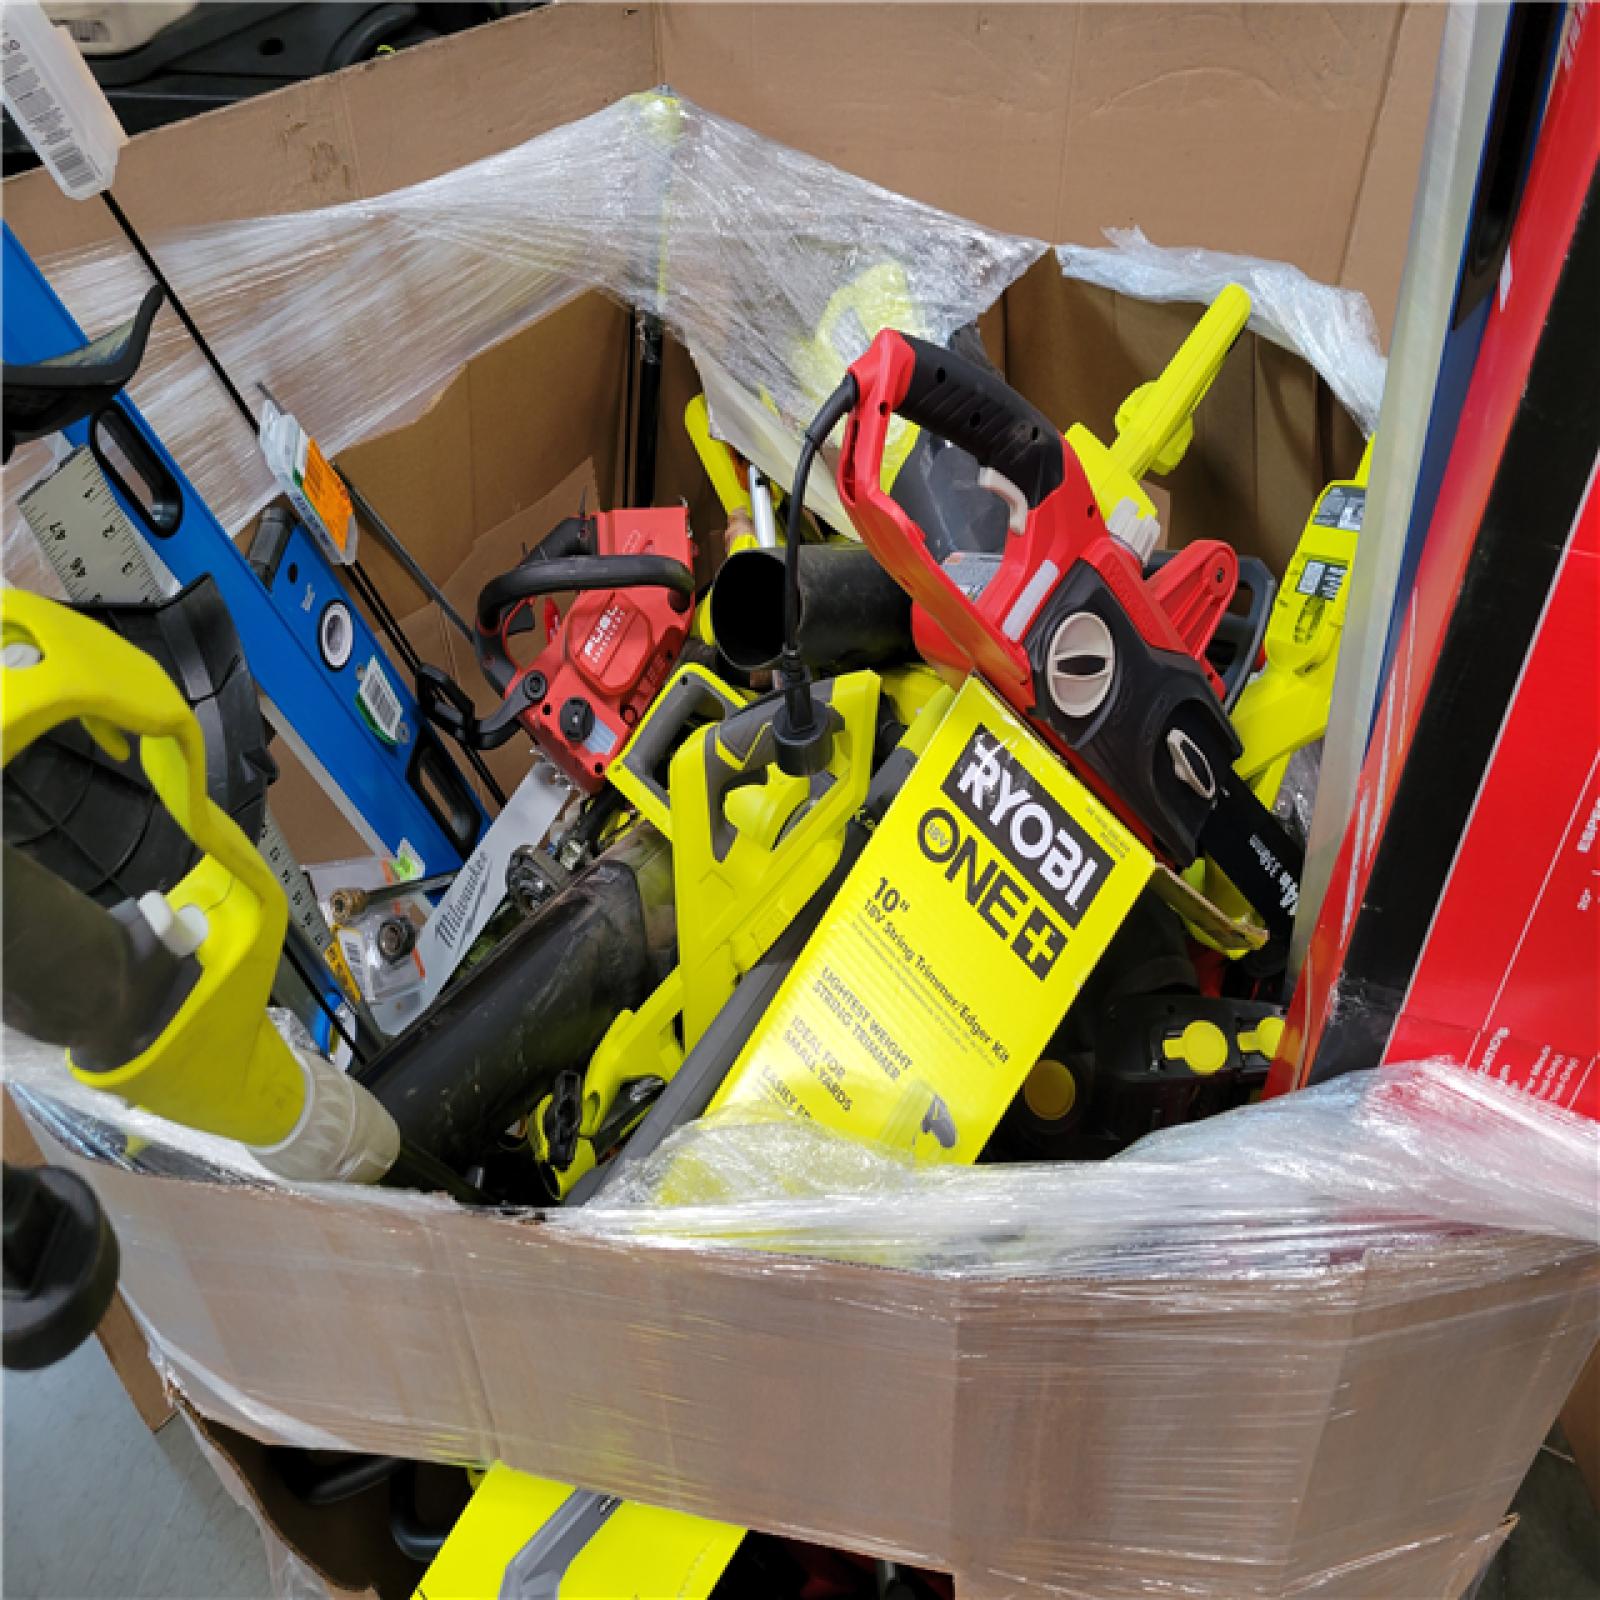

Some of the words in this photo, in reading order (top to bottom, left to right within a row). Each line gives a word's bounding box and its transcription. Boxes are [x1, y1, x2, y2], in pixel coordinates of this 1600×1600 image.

[957, 752, 1099, 908] RYOBI
[434, 851, 489, 948] Milwaukee
[872, 875, 911, 914] 10"
[811, 979, 856, 1028] STRING
[849, 1023, 903, 1081] TRIMMER
[819, 966, 872, 1022] LIGHTEST
[866, 1018, 914, 1070] WEIGHT
[863, 899, 887, 924] 18V
[881, 921, 919, 962] String
[911, 956, 996, 1045] Trimmer/Edger
[989, 1039, 1012, 1063] Kit
[781, 1029, 822, 1072] SMALL
[814, 1067, 856, 1112] YARDS
[789, 1014, 827, 1054] IDEAL
[820, 1050, 848, 1079] FOR
